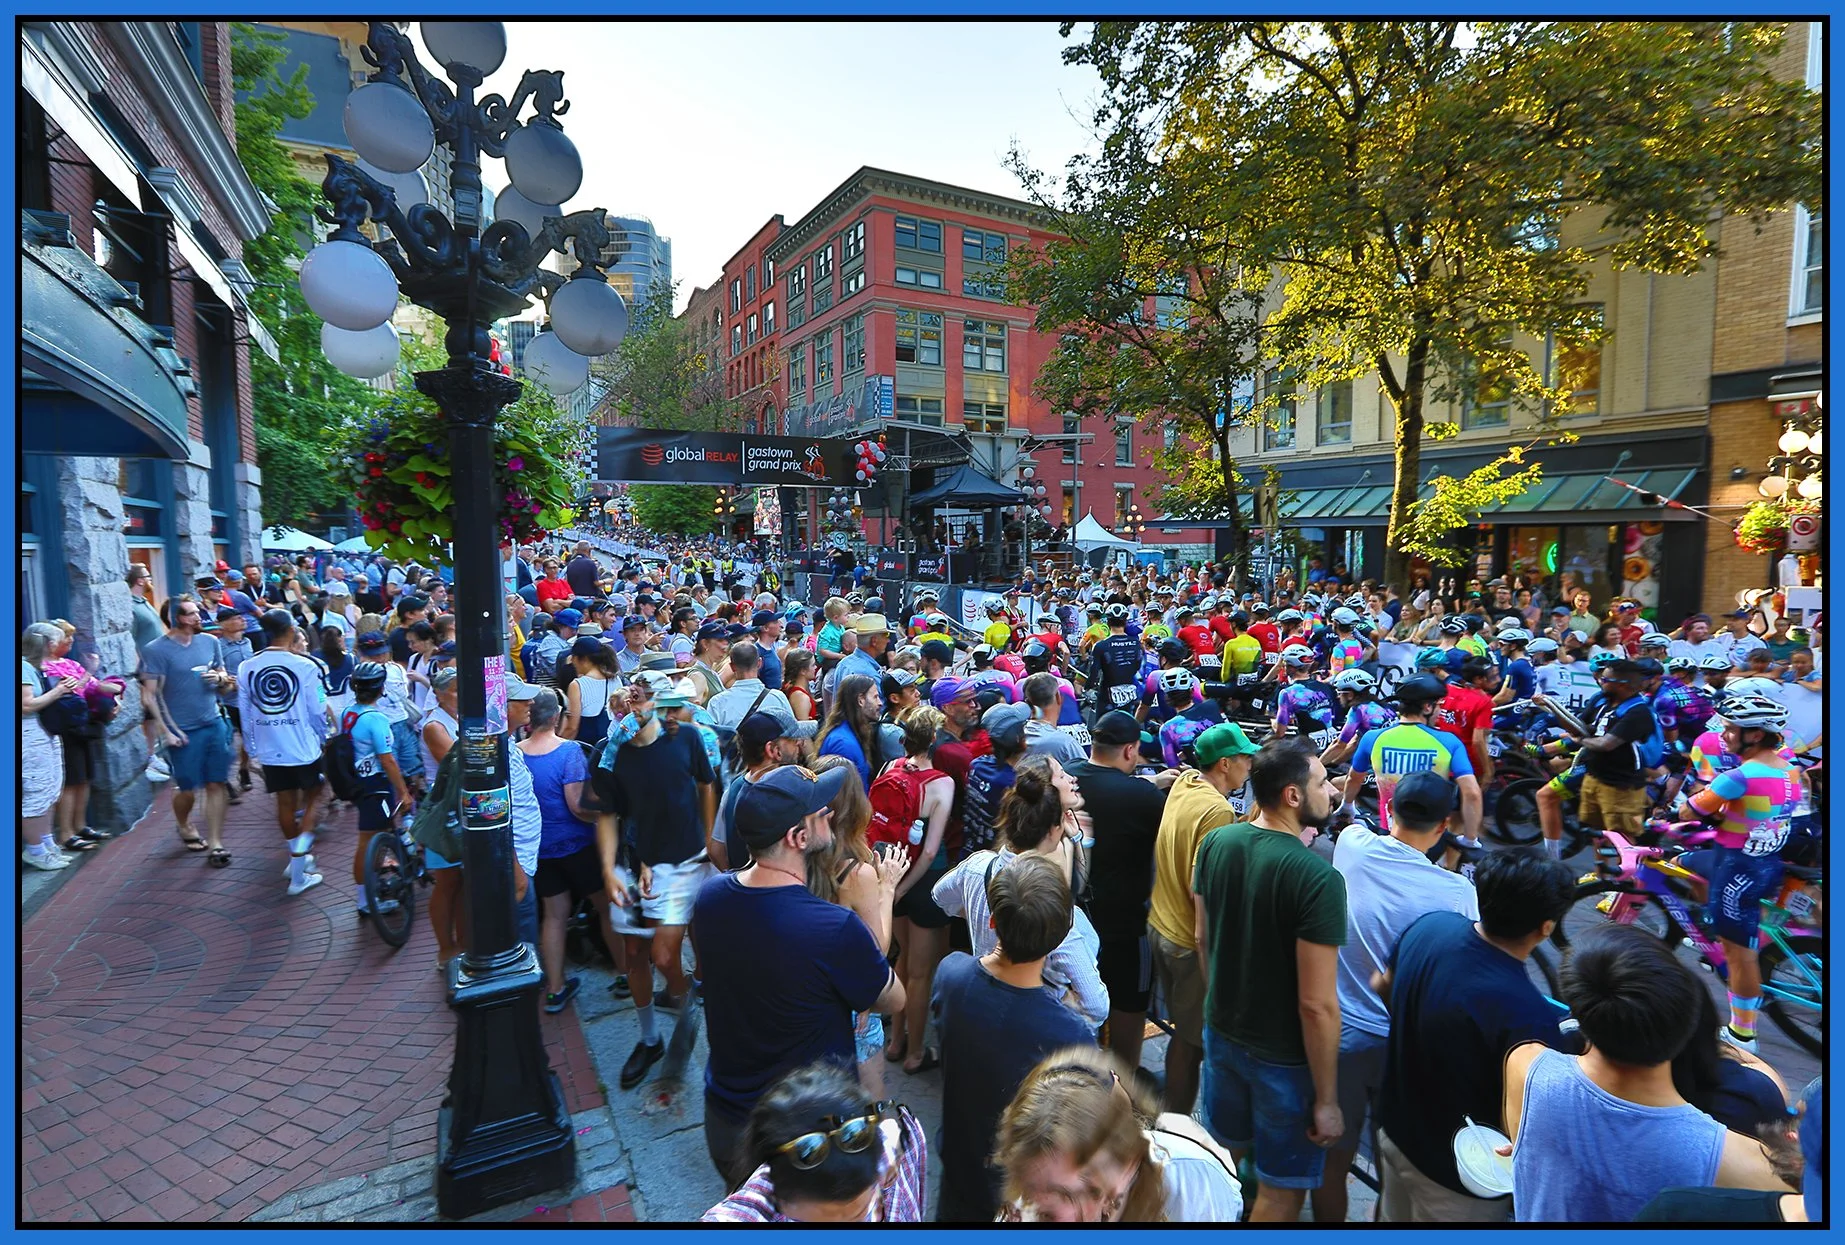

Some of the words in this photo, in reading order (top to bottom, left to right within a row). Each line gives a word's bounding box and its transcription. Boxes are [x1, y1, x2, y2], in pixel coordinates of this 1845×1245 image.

[666, 446, 705, 464] global
[706, 451, 738, 463] RELAY
[748, 446, 793, 460] gastown
[748, 459, 780, 472] grand
[782, 459, 801, 473] prix
[1382, 747, 1437, 774] FUTURE
